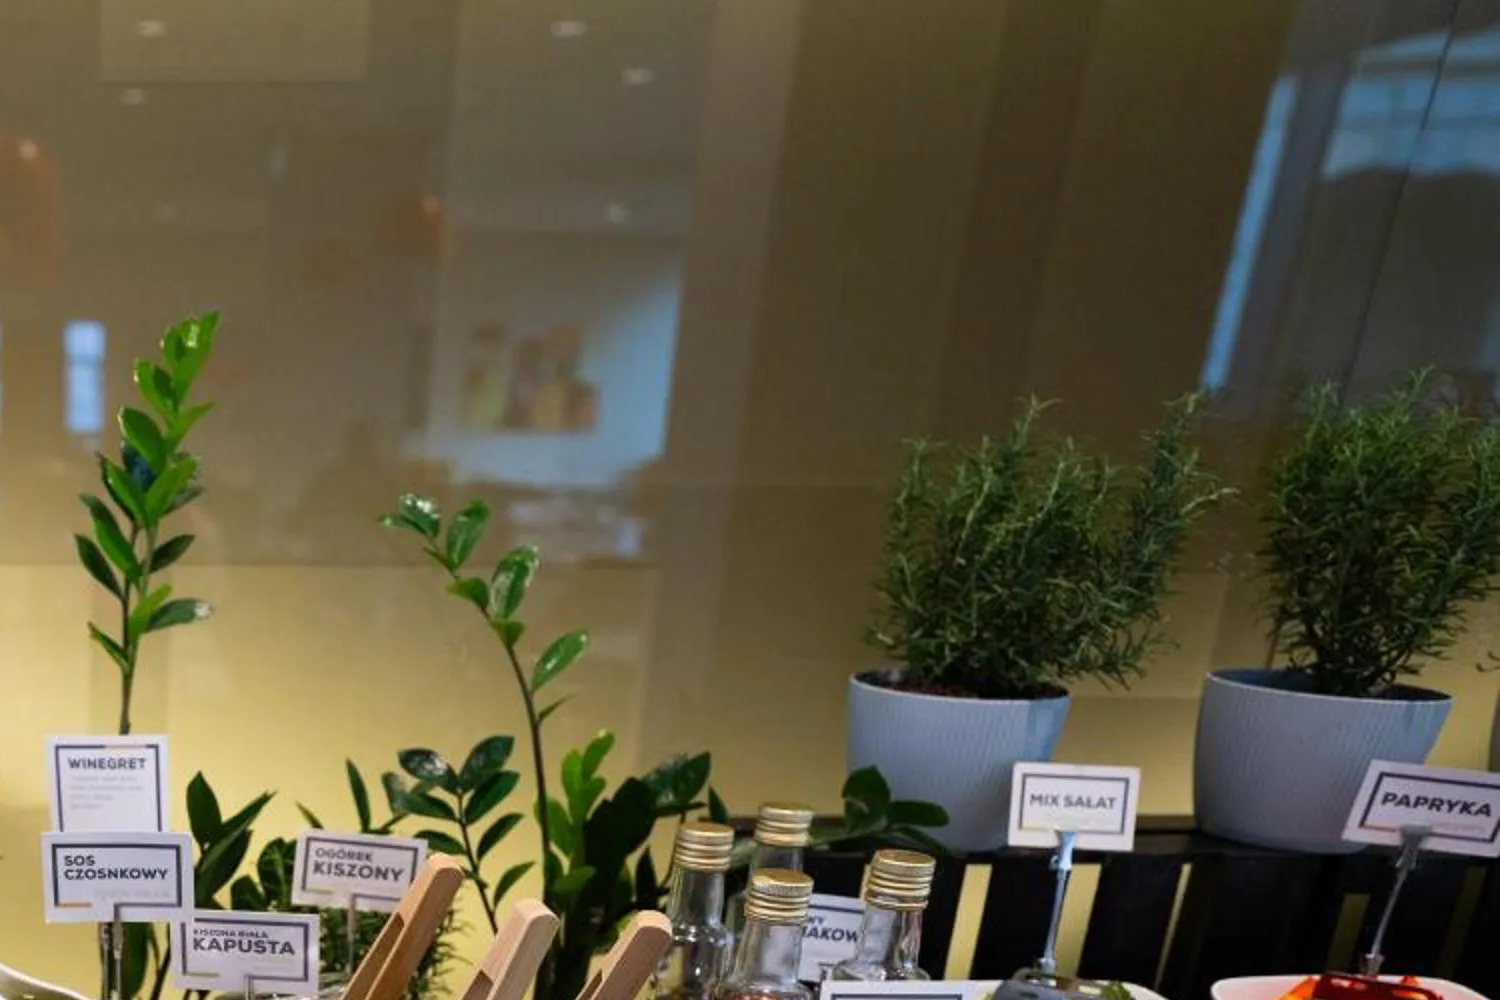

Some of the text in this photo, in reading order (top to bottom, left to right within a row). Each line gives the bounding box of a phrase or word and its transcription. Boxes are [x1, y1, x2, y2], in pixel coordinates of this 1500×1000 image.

[67, 757, 147, 770] WINEGRET
[1029, 793, 1117, 810] MIX SALAT
[1381, 791, 1492, 817] PAPRYKA
[63, 855, 96, 867] SOS
[315, 846, 373, 863] OGÓREK
[63, 867, 168, 881] CZOSNKOWY
[312, 860, 405, 882] KISZONY
[192, 937, 296, 956] KAPUSTA
